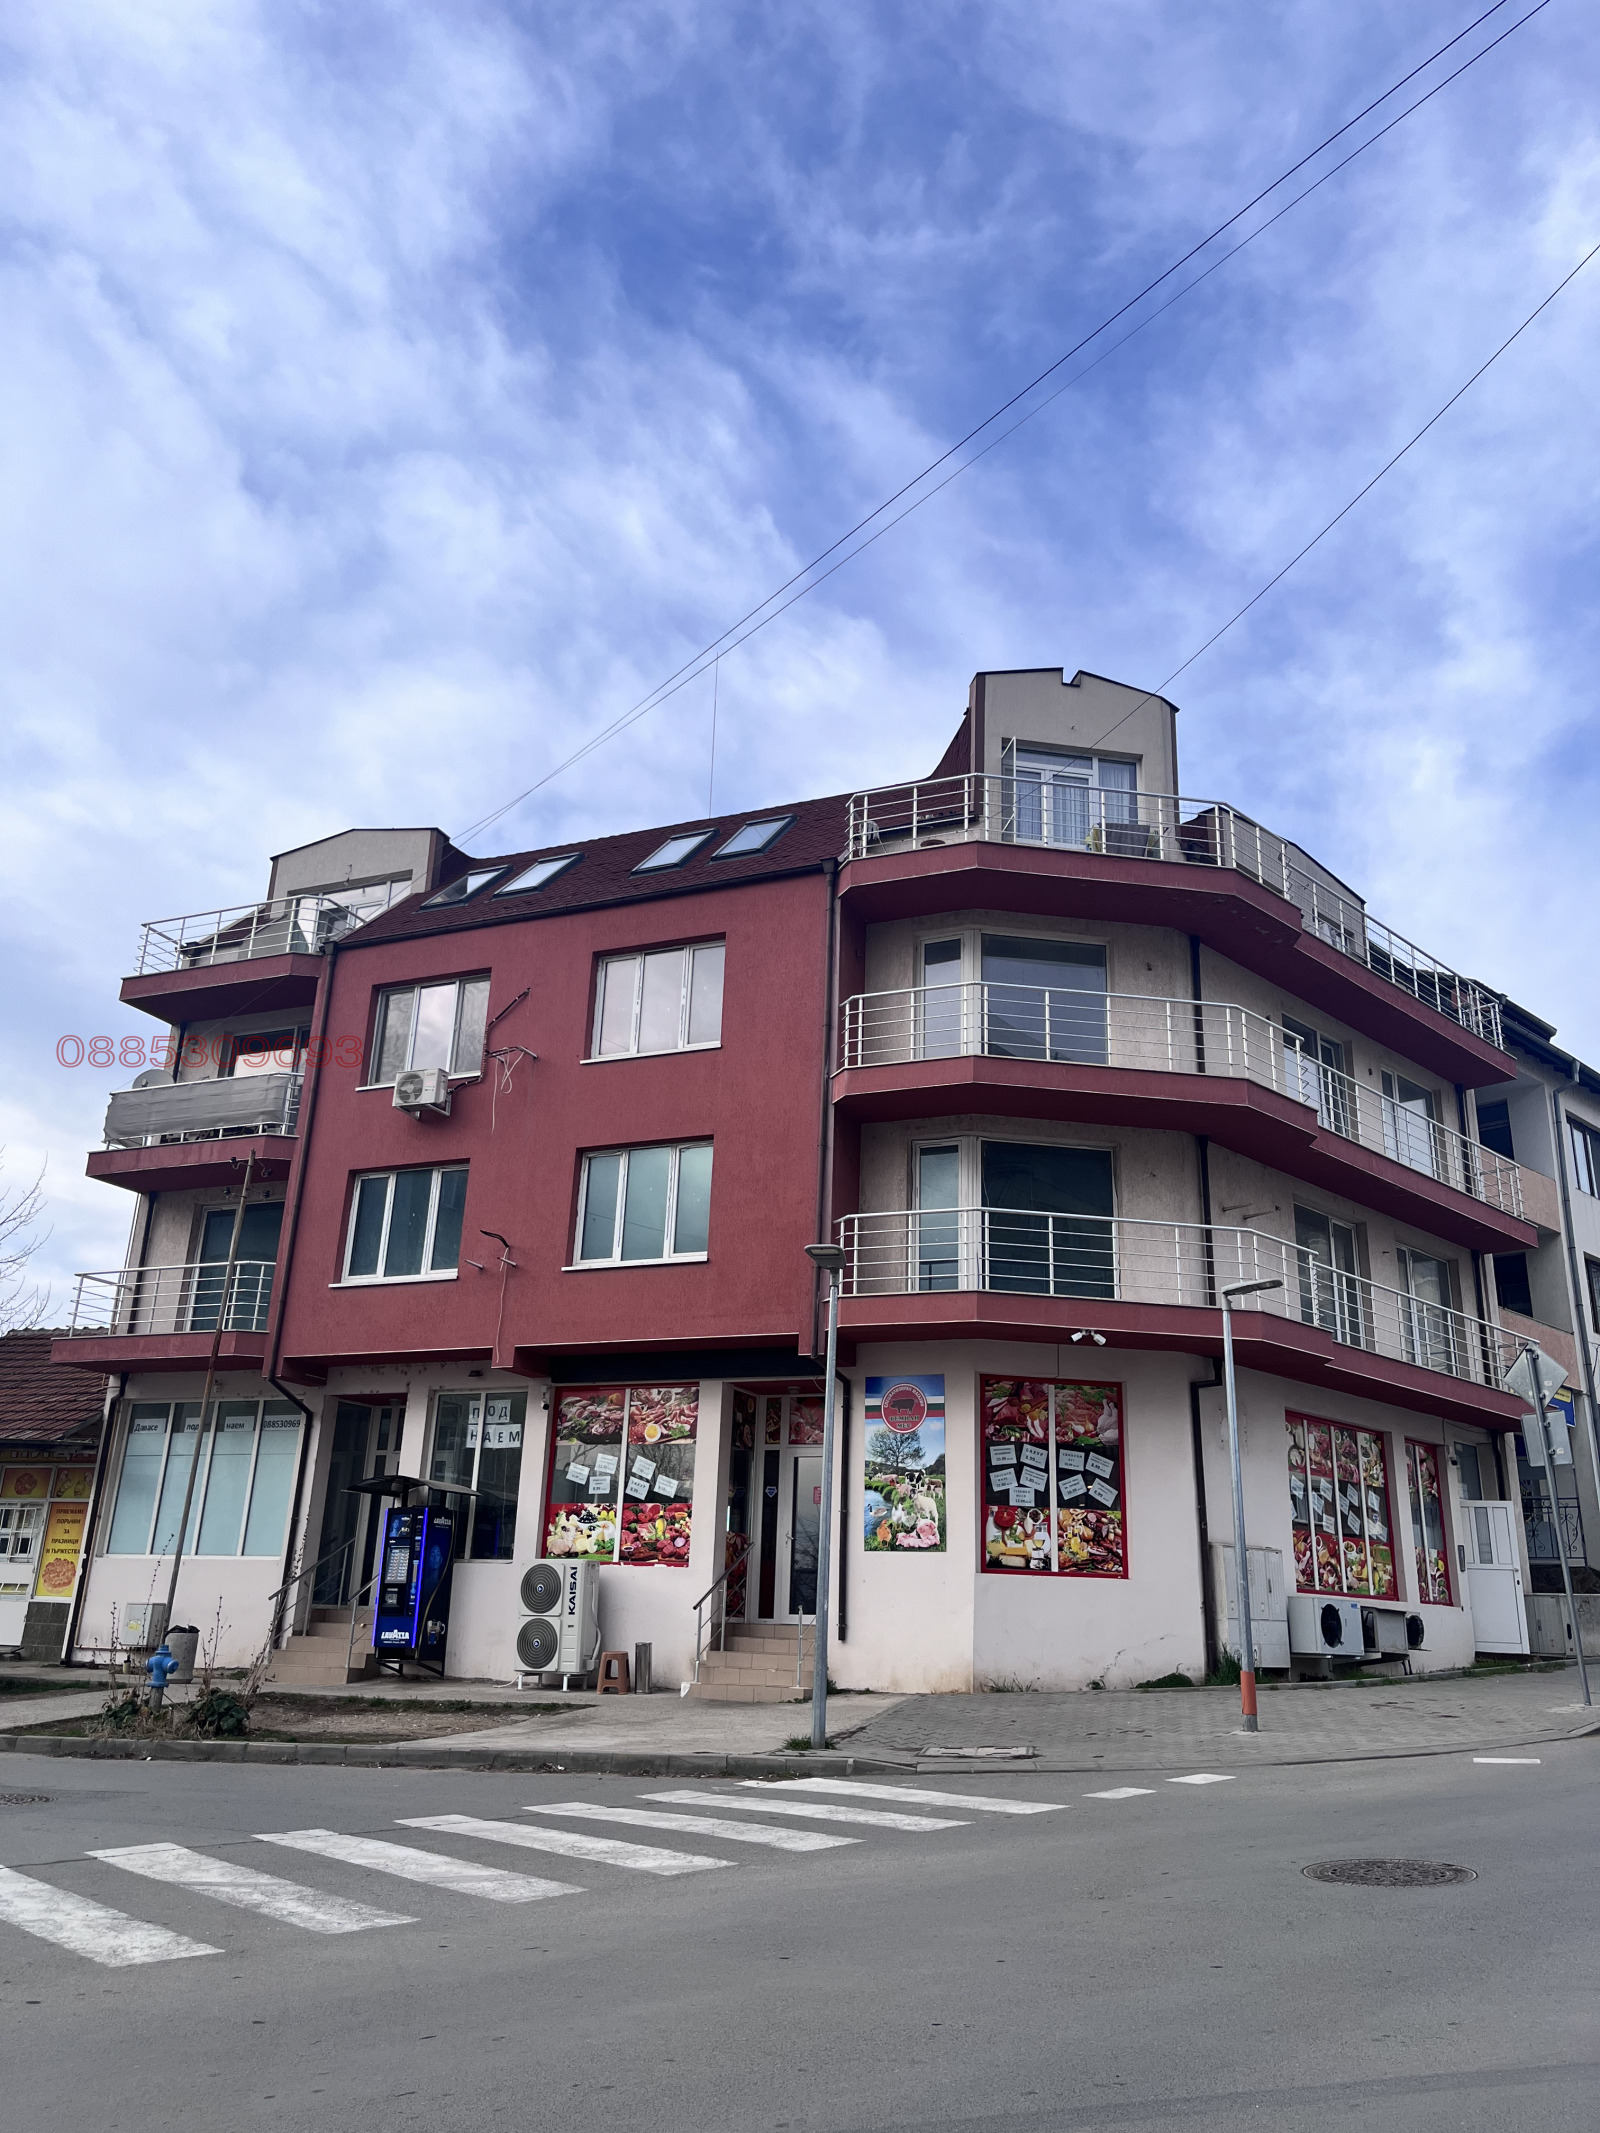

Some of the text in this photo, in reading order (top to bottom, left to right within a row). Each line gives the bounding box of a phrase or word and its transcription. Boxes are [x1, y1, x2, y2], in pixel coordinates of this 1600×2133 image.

[472, 1405, 508, 1420] ПОД
[134, 1423, 159, 1433] Давасе
[226, 1422, 245, 1430] наем
[470, 1429, 520, 1443] НАЕМ
[568, 1566, 578, 1615] KAISAI
[380, 1628, 410, 1640] LAVAZZA
